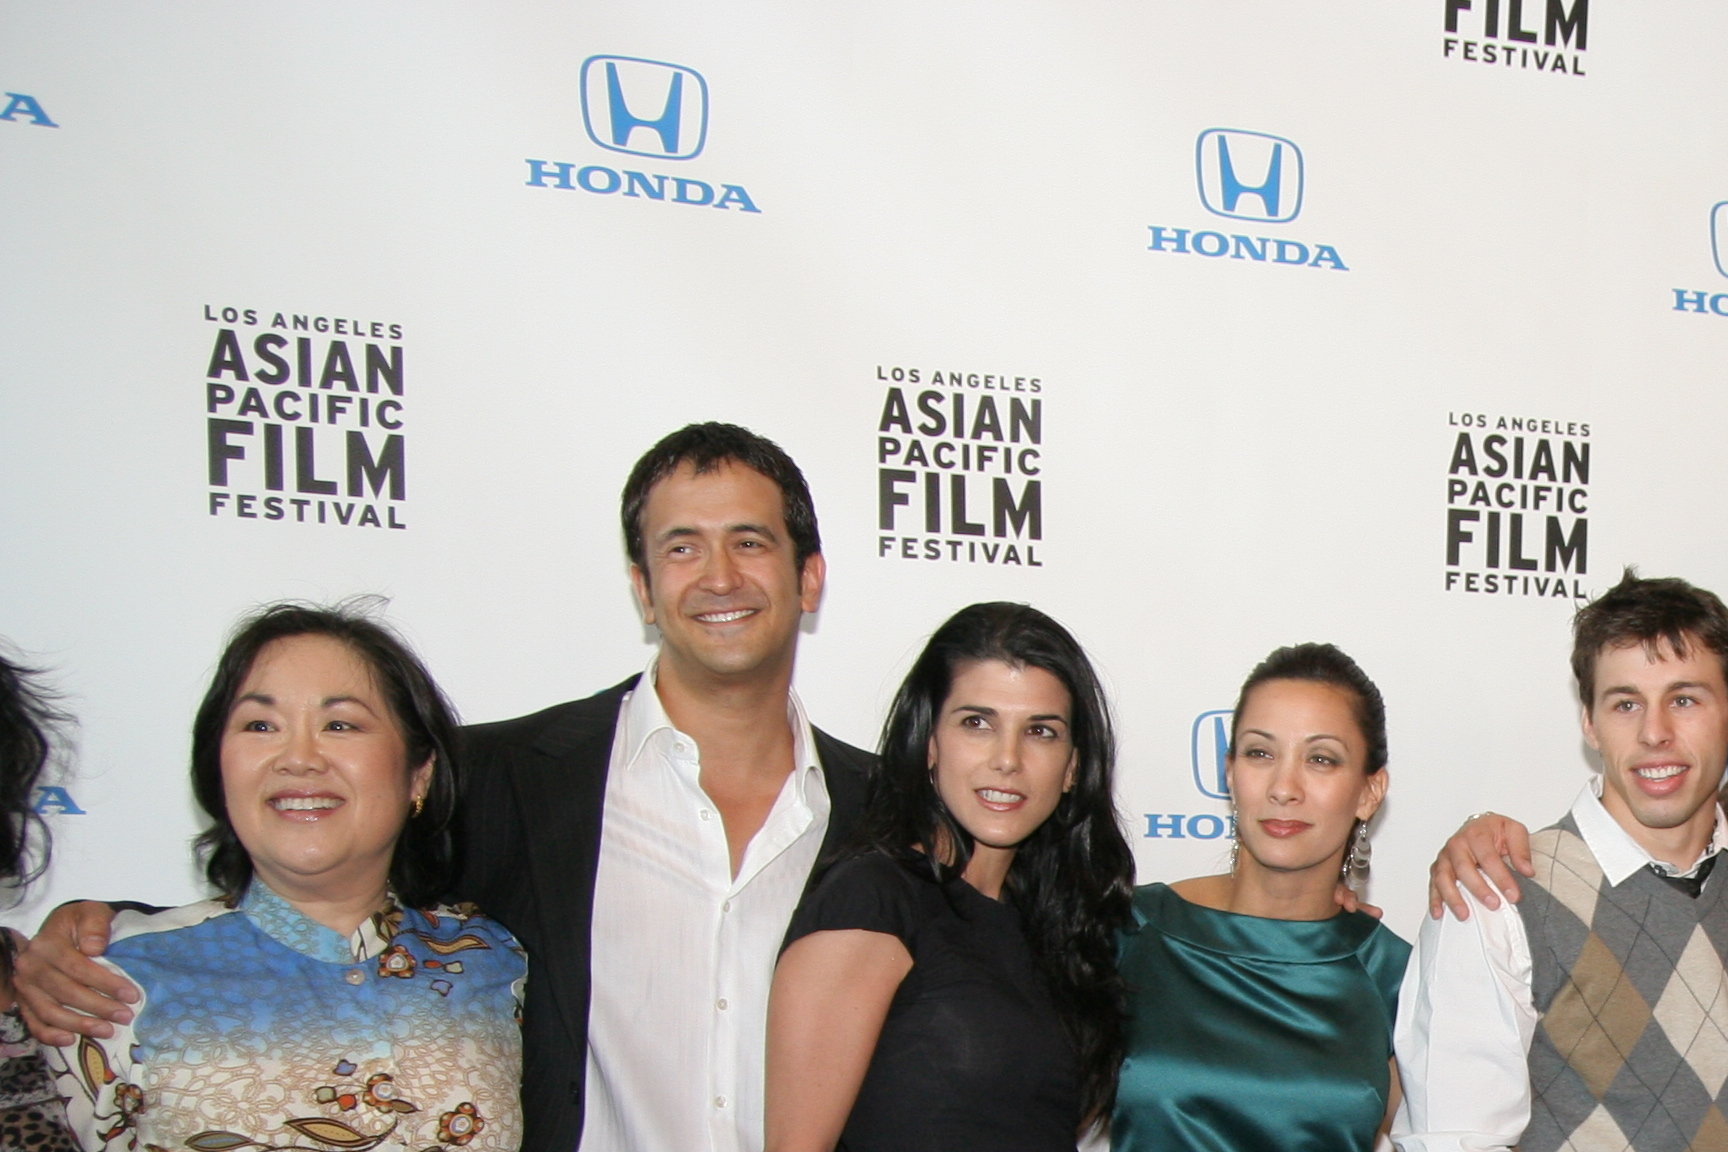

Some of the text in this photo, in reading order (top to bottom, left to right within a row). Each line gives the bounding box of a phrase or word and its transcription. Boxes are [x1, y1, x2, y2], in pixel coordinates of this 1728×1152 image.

[1443, 38, 1586, 76] FESTIVAL
[525, 158, 762, 214] HONDA
[1147, 225, 1350, 271] HONDA
[204, 304, 403, 340] LOS ANGELES
[206, 328, 404, 397] ASIAN
[877, 366, 1042, 393] LOS ANGELES
[206, 382, 405, 430] PACIFIC
[879, 386, 1042, 445] ASIAN
[1449, 411, 1591, 437] LOS ANGELES
[207, 417, 406, 501] FILM
[878, 436, 1041, 476] PACIFIC
[1449, 431, 1590, 485] ASIAN
[209, 492, 407, 529] FESTIVAL
[878, 467, 1042, 541] FILM
[1448, 478, 1589, 514] PACIFIC
[879, 536, 1043, 567] FESTIVAL
[1446, 508, 1588, 575] FILM
[1445, 571, 1588, 599] FESTIVAL
